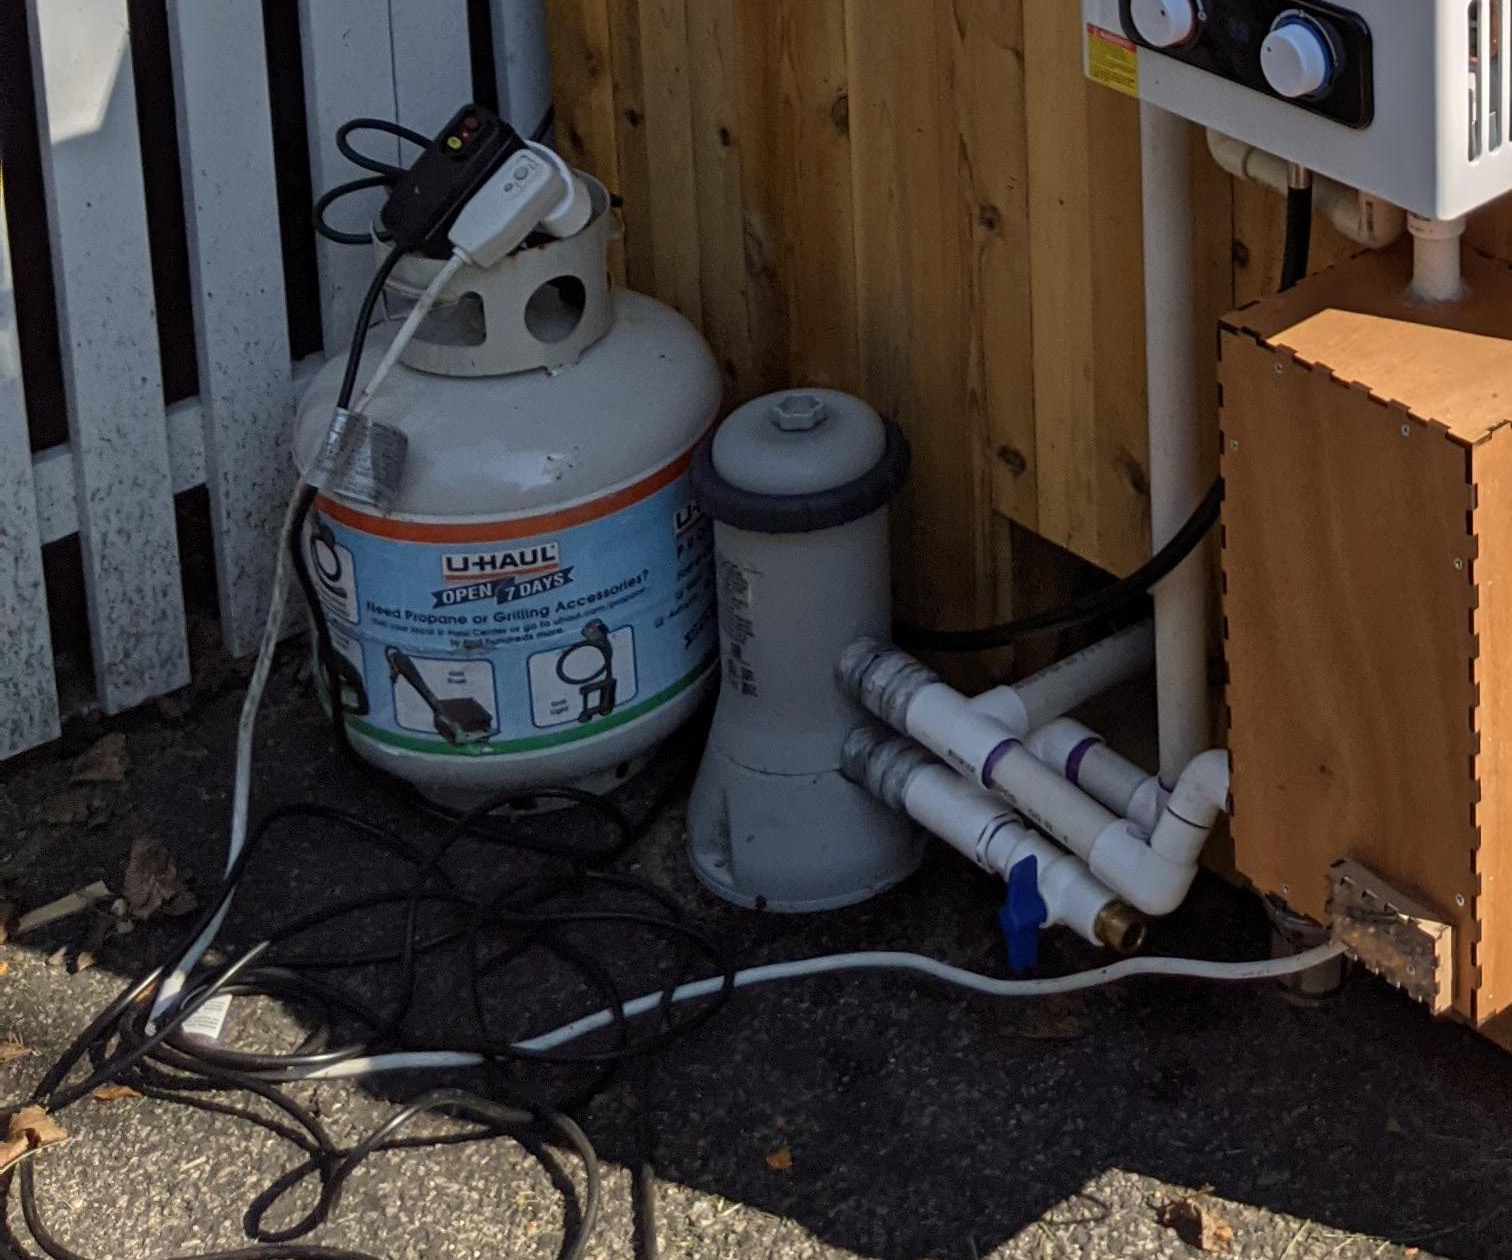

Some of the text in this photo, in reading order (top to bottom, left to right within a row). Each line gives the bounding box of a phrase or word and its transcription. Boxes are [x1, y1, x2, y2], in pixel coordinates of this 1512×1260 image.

[446, 547, 556, 572] U-HAUL
[366, 568, 649, 625] Need Propane or Grilling Accessories?
[442, 572, 564, 604] OPEN 7 DAYS
